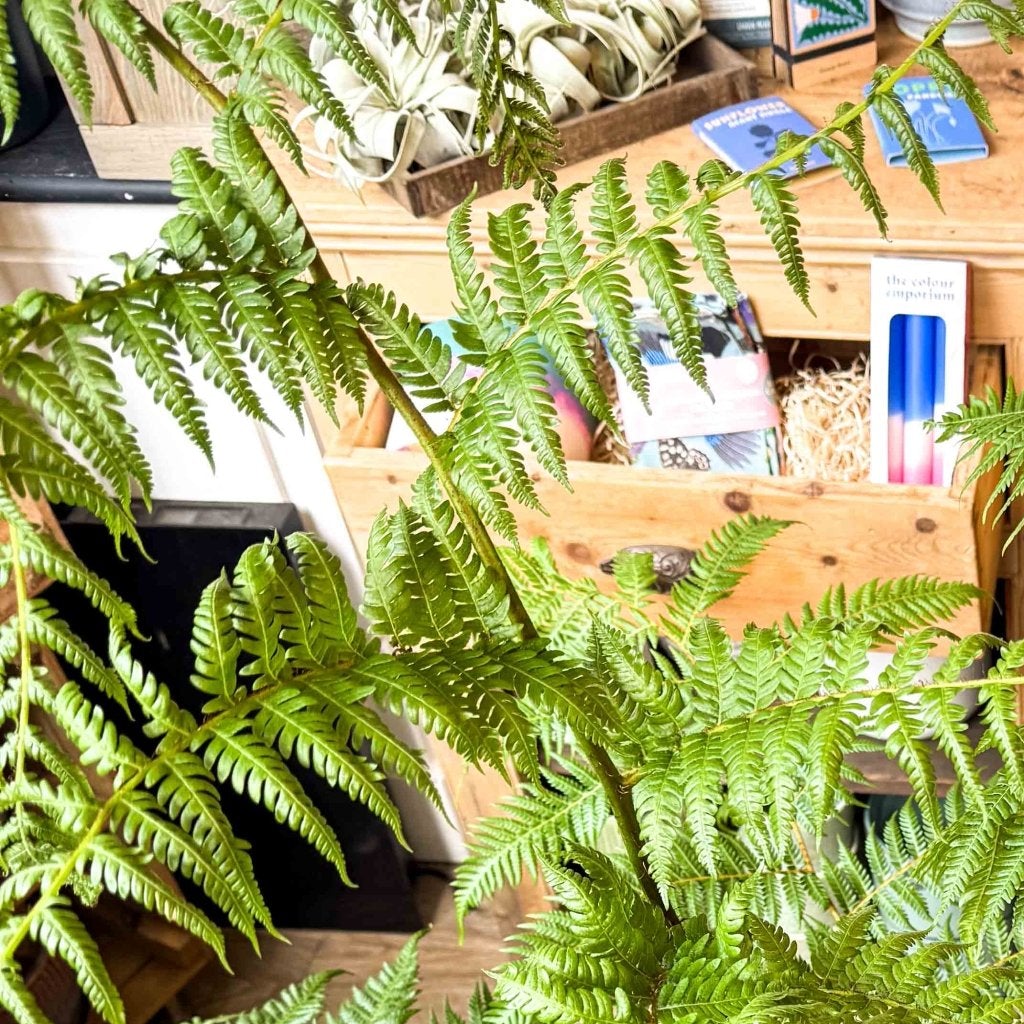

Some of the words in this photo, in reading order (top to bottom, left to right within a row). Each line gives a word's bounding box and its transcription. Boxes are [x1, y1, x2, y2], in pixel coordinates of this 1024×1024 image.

[886, 275, 907, 286] the
[912, 277, 955, 289] colour
[886, 289, 956, 302] emporium
